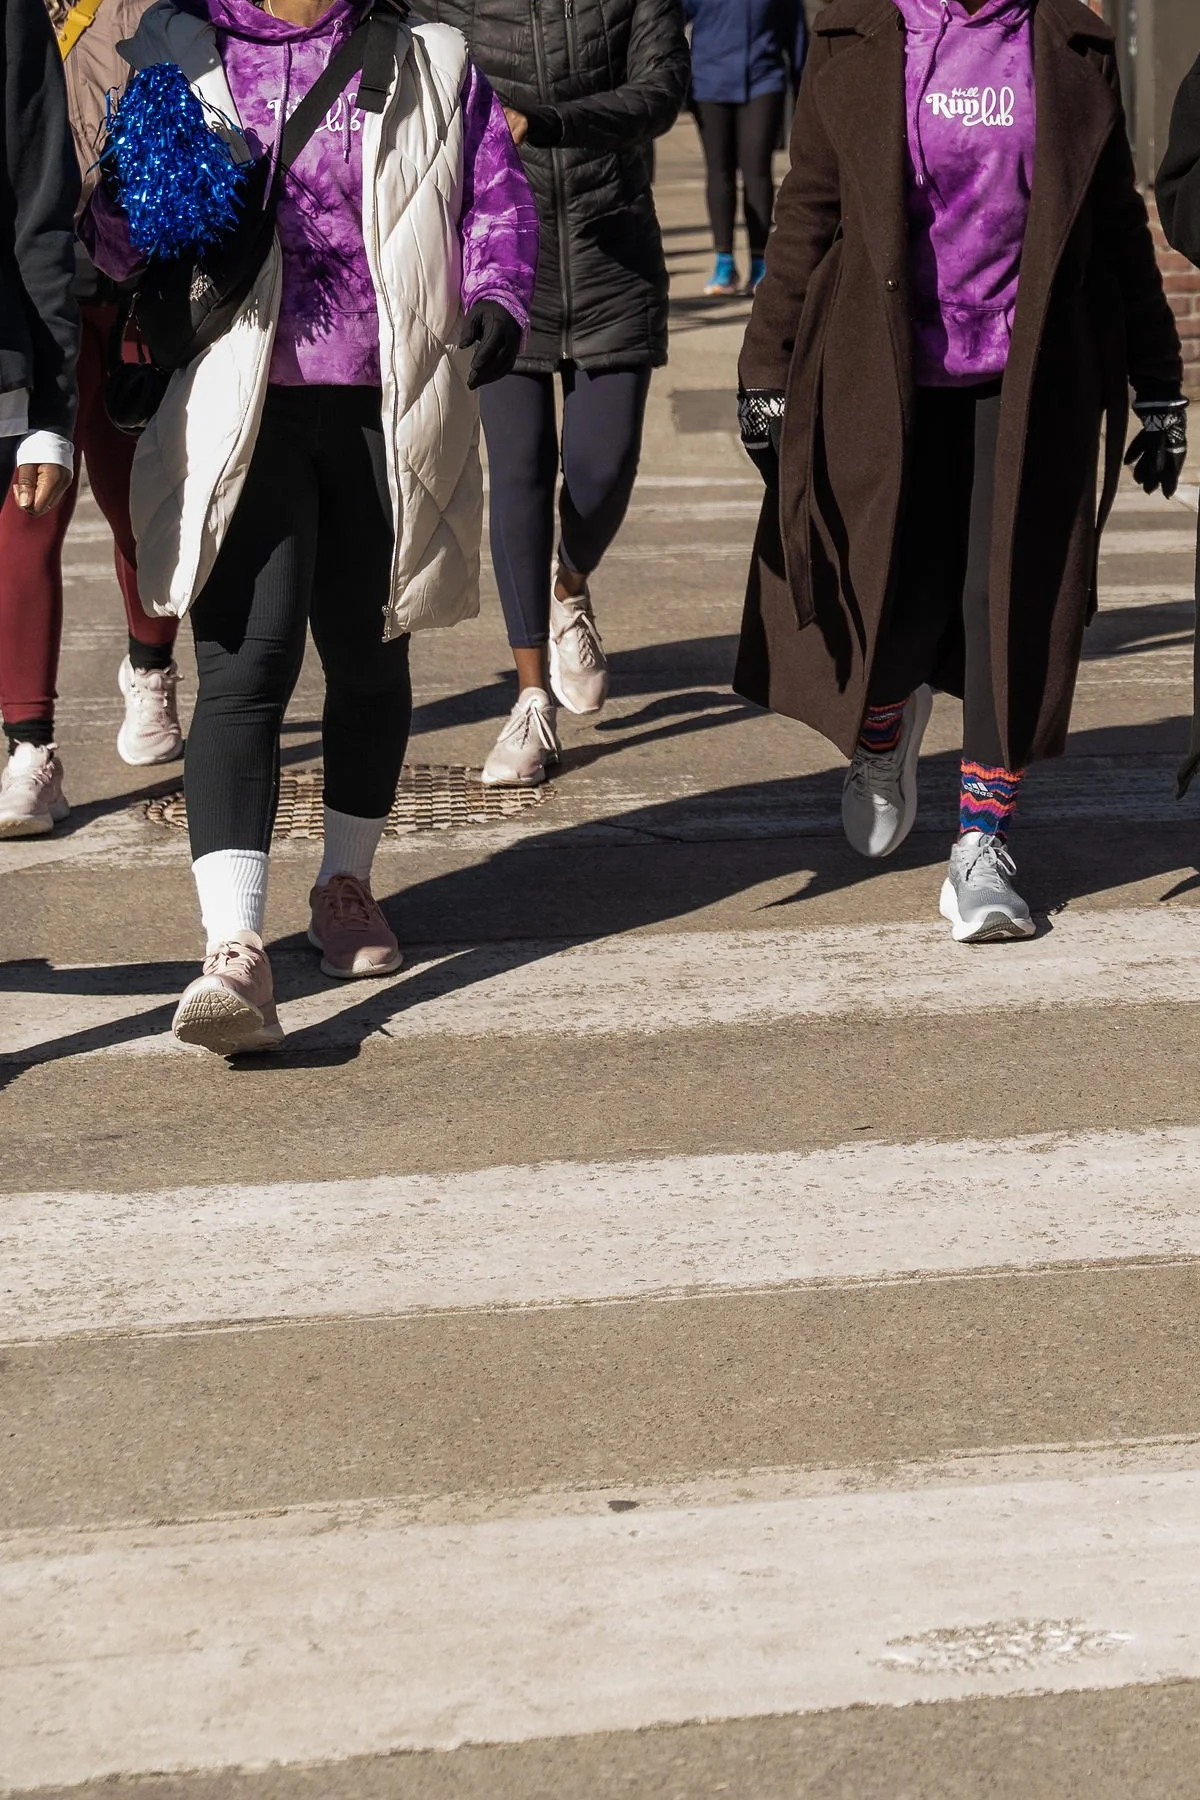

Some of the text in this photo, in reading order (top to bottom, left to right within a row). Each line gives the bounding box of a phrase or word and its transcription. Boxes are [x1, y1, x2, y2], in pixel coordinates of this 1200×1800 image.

[951, 87, 979, 98] Hill
[925, 93, 979, 119] Run
[963, 784, 994, 798] adidas
